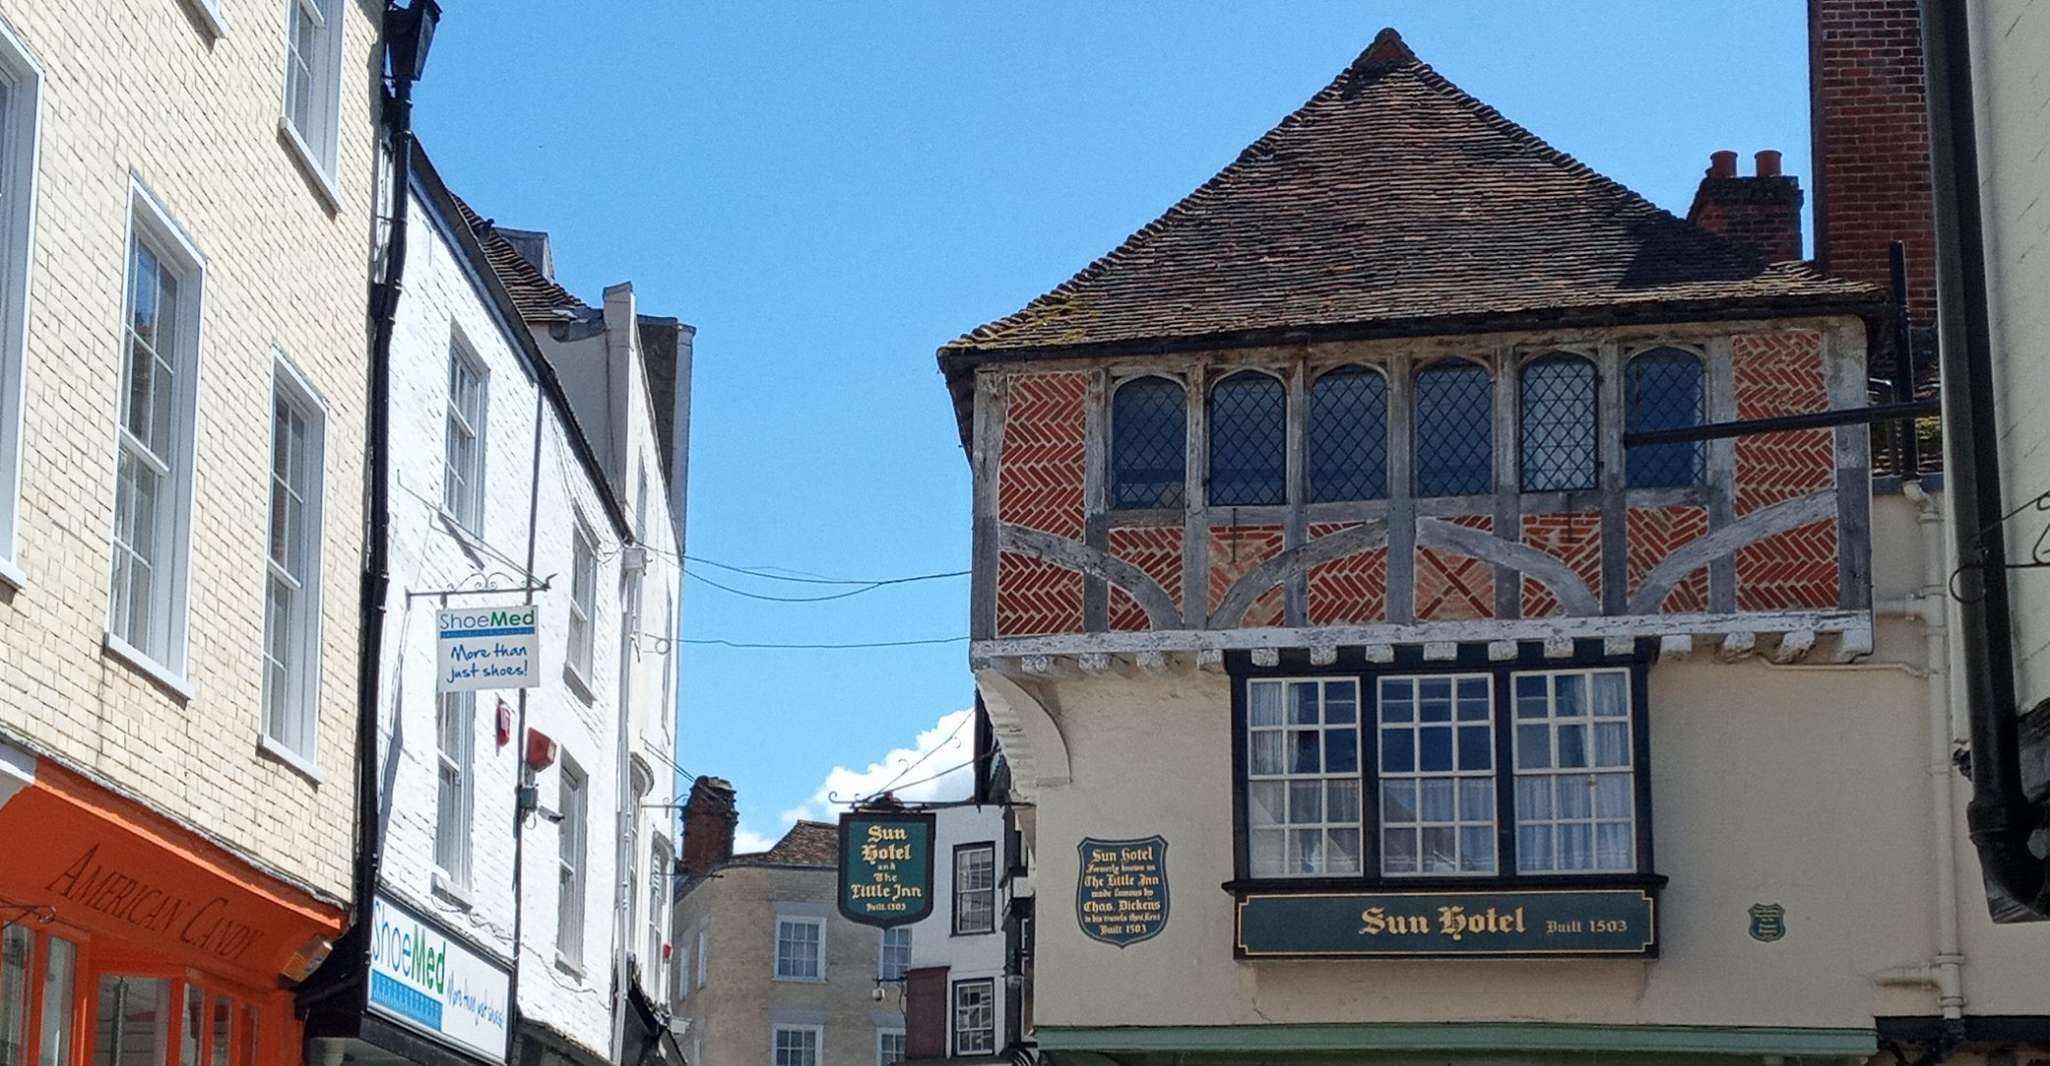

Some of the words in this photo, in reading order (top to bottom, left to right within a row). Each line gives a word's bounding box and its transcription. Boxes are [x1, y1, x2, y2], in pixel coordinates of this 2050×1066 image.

[440, 609, 535, 630] ShoeMed
[450, 643, 491, 661] More
[493, 642, 527, 657] than
[446, 662, 480, 684] just
[482, 659, 528, 677] shoes!
[867, 825, 908, 843] Sun
[861, 843, 912, 865] Hotel
[1092, 848, 1117, 862] Sun
[1121, 846, 1153, 863] Hotel
[877, 862, 896, 870] and
[1086, 863, 1119, 874] Formerly
[1121, 863, 1144, 872] known
[873, 872, 898, 882] The
[1084, 875, 1104, 888] The
[1106, 874, 1135, 888] Little
[1138, 873, 1159, 887] Inn
[850, 883, 891, 899] Little
[891, 883, 922, 901] Inn
[1091, 888, 1112, 898] made
[1114, 888, 1142, 897] famous
[1143, 888, 1154, 899] by
[1119, 899, 1161, 911] Dickens
[1100, 924, 1122, 935] Built
[1126, 923, 1147, 933] 1503
[1358, 907, 1430, 935] Sun
[1437, 905, 1528, 941] Hotel
[1545, 920, 1583, 935] Built
[1589, 920, 1629, 933] 1503
[372, 900, 447, 995] ShoeMed
